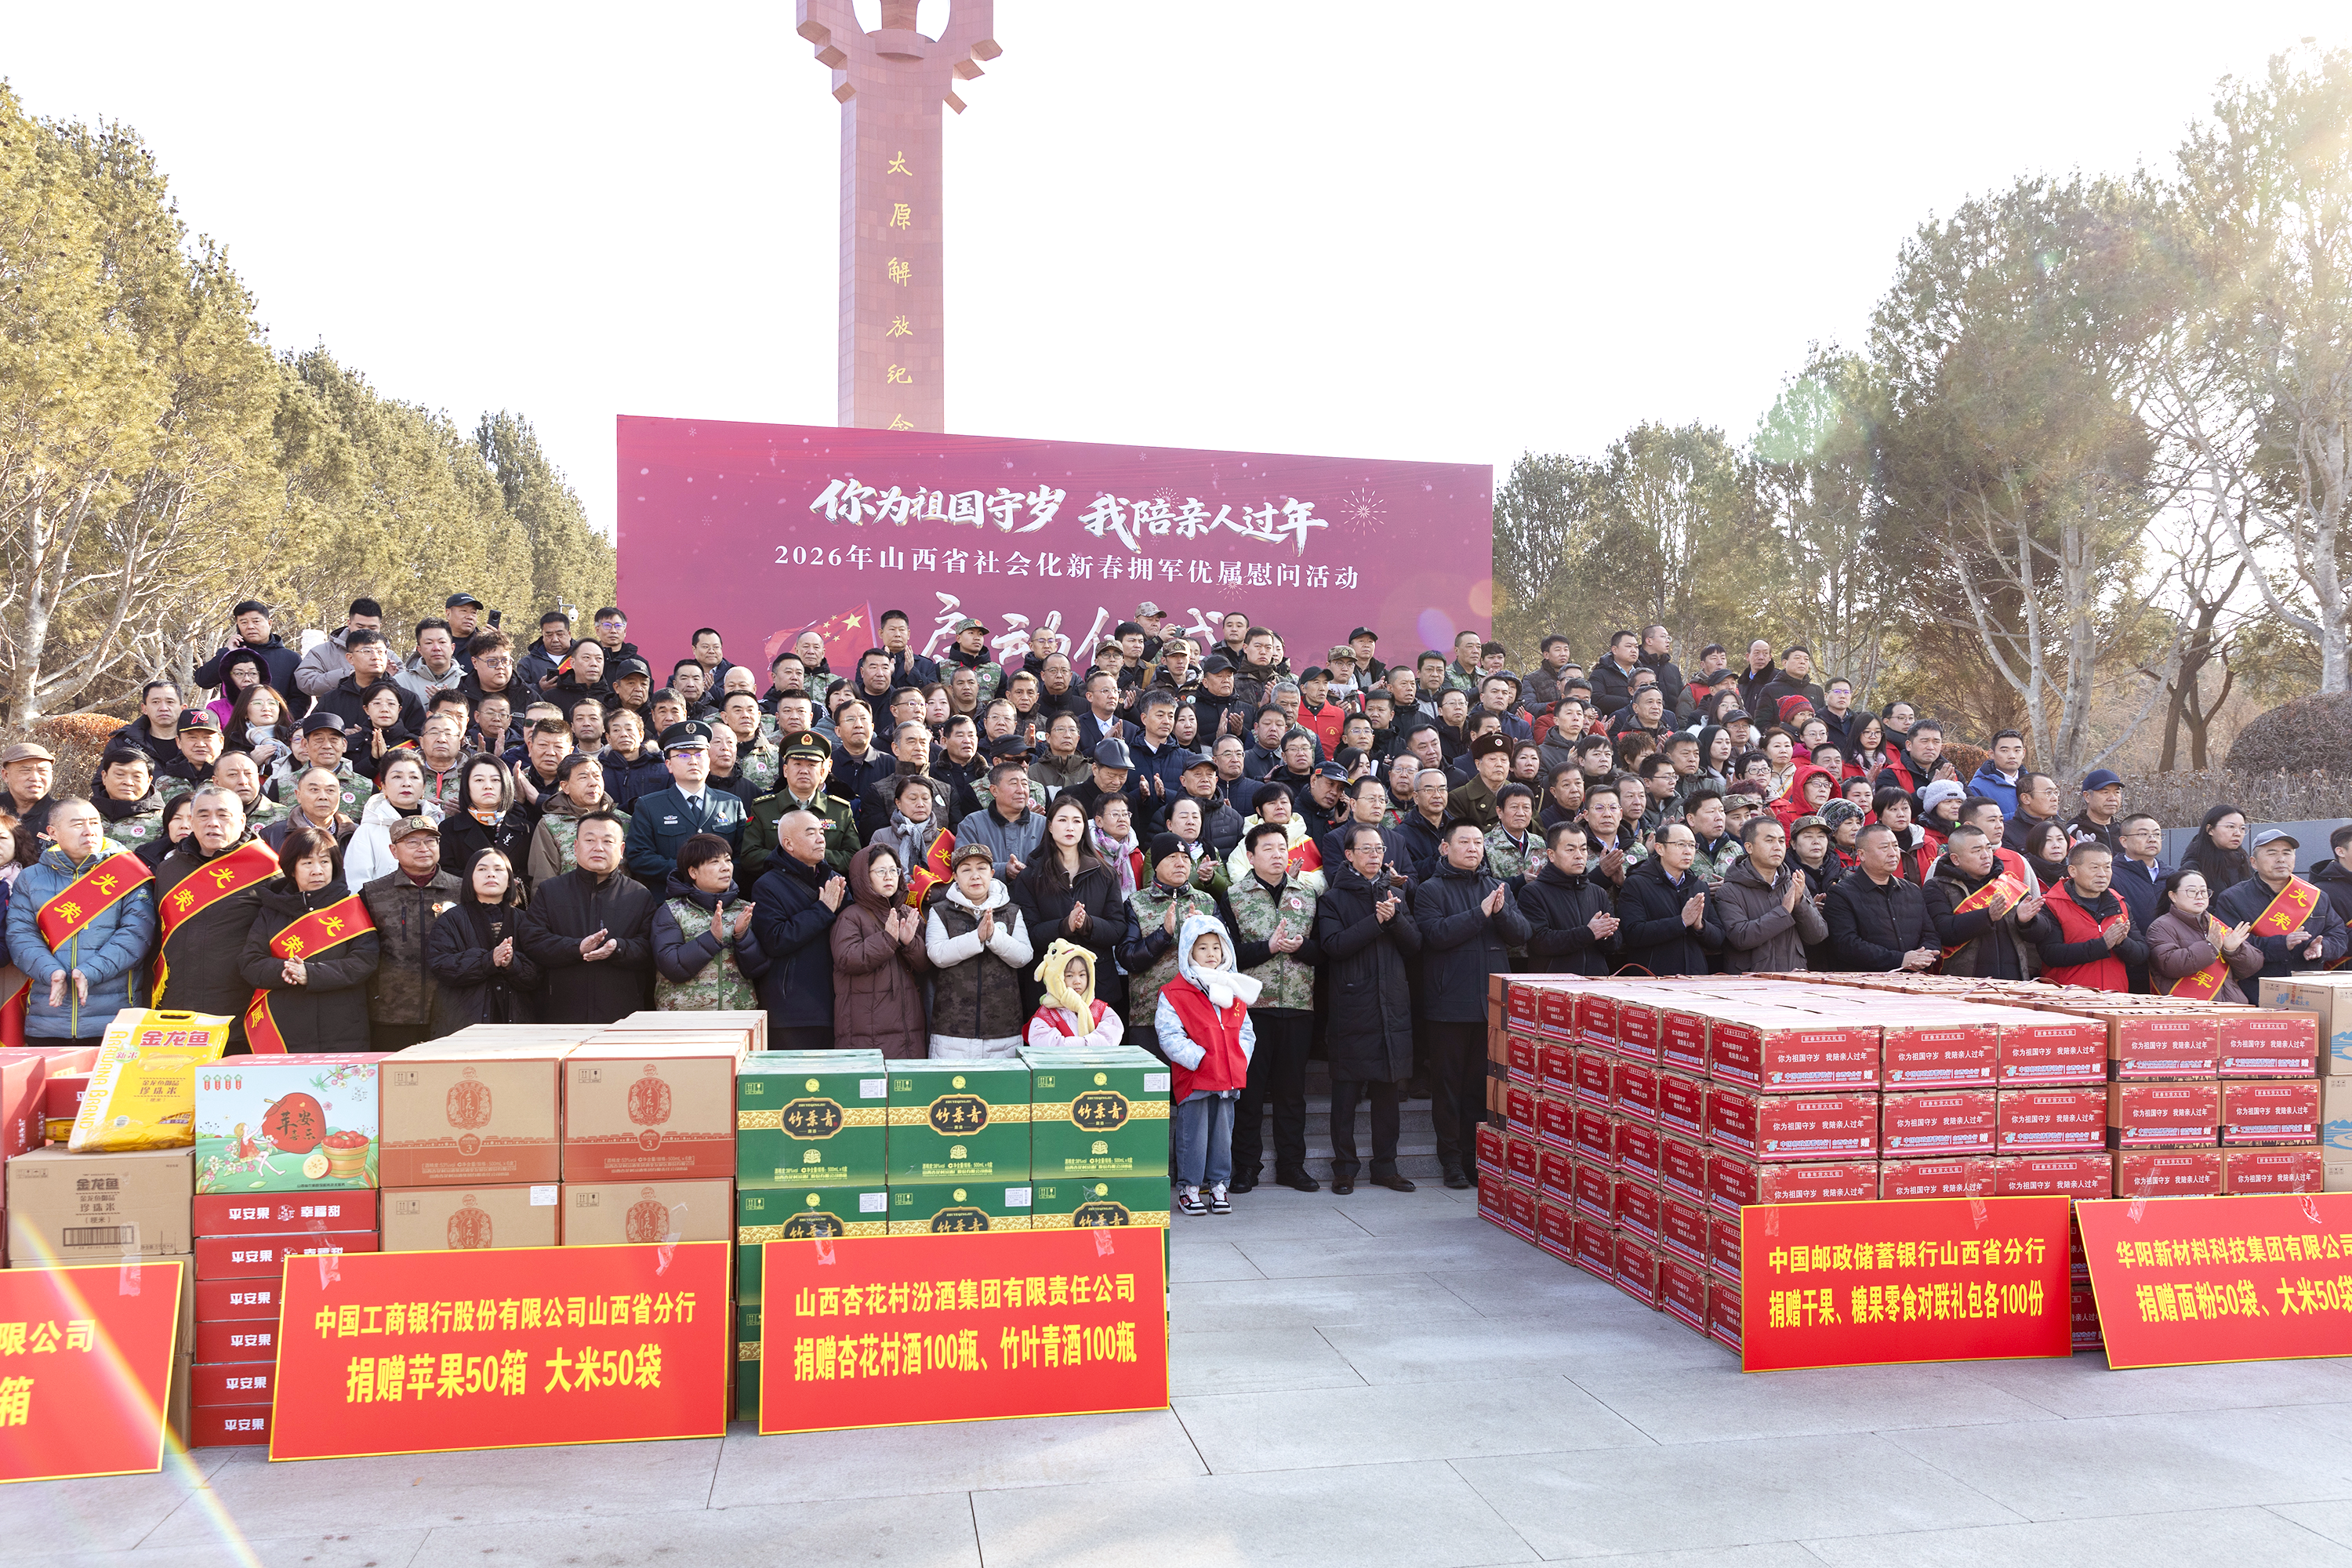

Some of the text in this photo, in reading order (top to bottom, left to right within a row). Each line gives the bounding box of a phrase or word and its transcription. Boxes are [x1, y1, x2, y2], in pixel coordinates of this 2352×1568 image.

[809, 478, 1329, 557] 你为祖国守岁 我陪亲人过年
[775, 544, 1359, 591] 2026年山西省社会化新春拥军优属慰问活动
[172, 868, 235, 912] 光荣
[54, 873, 118, 924] 光荣
[2269, 888, 2308, 931] 光荣
[281, 916, 345, 958] 光荣
[140, 1030, 210, 1047] 金龙鱼
[2270, 1040, 2305, 1048] 我陪亲人过年
[115, 1051, 138, 1059] 新米
[1898, 1050, 1985, 1061] 你为祖国守岁 我陪亲人过年
[2057, 1046, 2095, 1054] 我陪亲人过年
[1778, 1052, 1867, 1063] 你为祖国守岁 我陪亲人过年
[1897, 1116, 1983, 1127] 你为祖国守岁 我陪亲人过年
[2012, 1114, 2094, 1123] 你为祖国守岁 我陪亲人过年
[1773, 1120, 1864, 1131] 你为祖国守岁 我陪亲人过年
[466, 1144, 473, 1153] 3
[647, 1139, 653, 1148] 3
[76, 1178, 120, 1191] 金龙鱼
[2009, 1180, 2098, 1190] 你为祖国守岁 我陪亲人过年
[2134, 1175, 2210, 1185] 你为祖国守岁 我陪亲人过年
[1775, 1187, 1864, 1199] 你为祖国守岁 我陪亲人过年
[1896, 1184, 1982, 1195] 你为祖国守岁 我陪亲人过年
[80, 1203, 115, 1213] 珍珠米
[229, 1205, 340, 1220] 平安果 幸福甜
[232, 1250, 273, 1262] 平安果
[1769, 1237, 2045, 1275] 中国邮政储蓄银行山西省分行
[2116, 1233, 2352, 1269] 华阳新材料科技集团有限公司
[230, 1292, 270, 1305] 平安果
[795, 1273, 1135, 1316] 山西杏花村汾酒集团有限责任公司
[2136, 1276, 2352, 1323] 捐赠面粉50袋、大米50袋
[1769, 1279, 2044, 1329] 捐赠干果、糖果零食对联礼包各100份
[315, 1291, 696, 1338] 中国工商银行股份有限公司山西省分行
[230, 1334, 271, 1347] 平安果
[794, 1321, 1137, 1381] 捐赠杏花村酒100瓶、竹叶青酒100瓶
[347, 1343, 662, 1403] 捐赠苹果50箱 大米50袋
[226, 1377, 267, 1389] 平安果
[224, 1418, 264, 1432] 平安果
